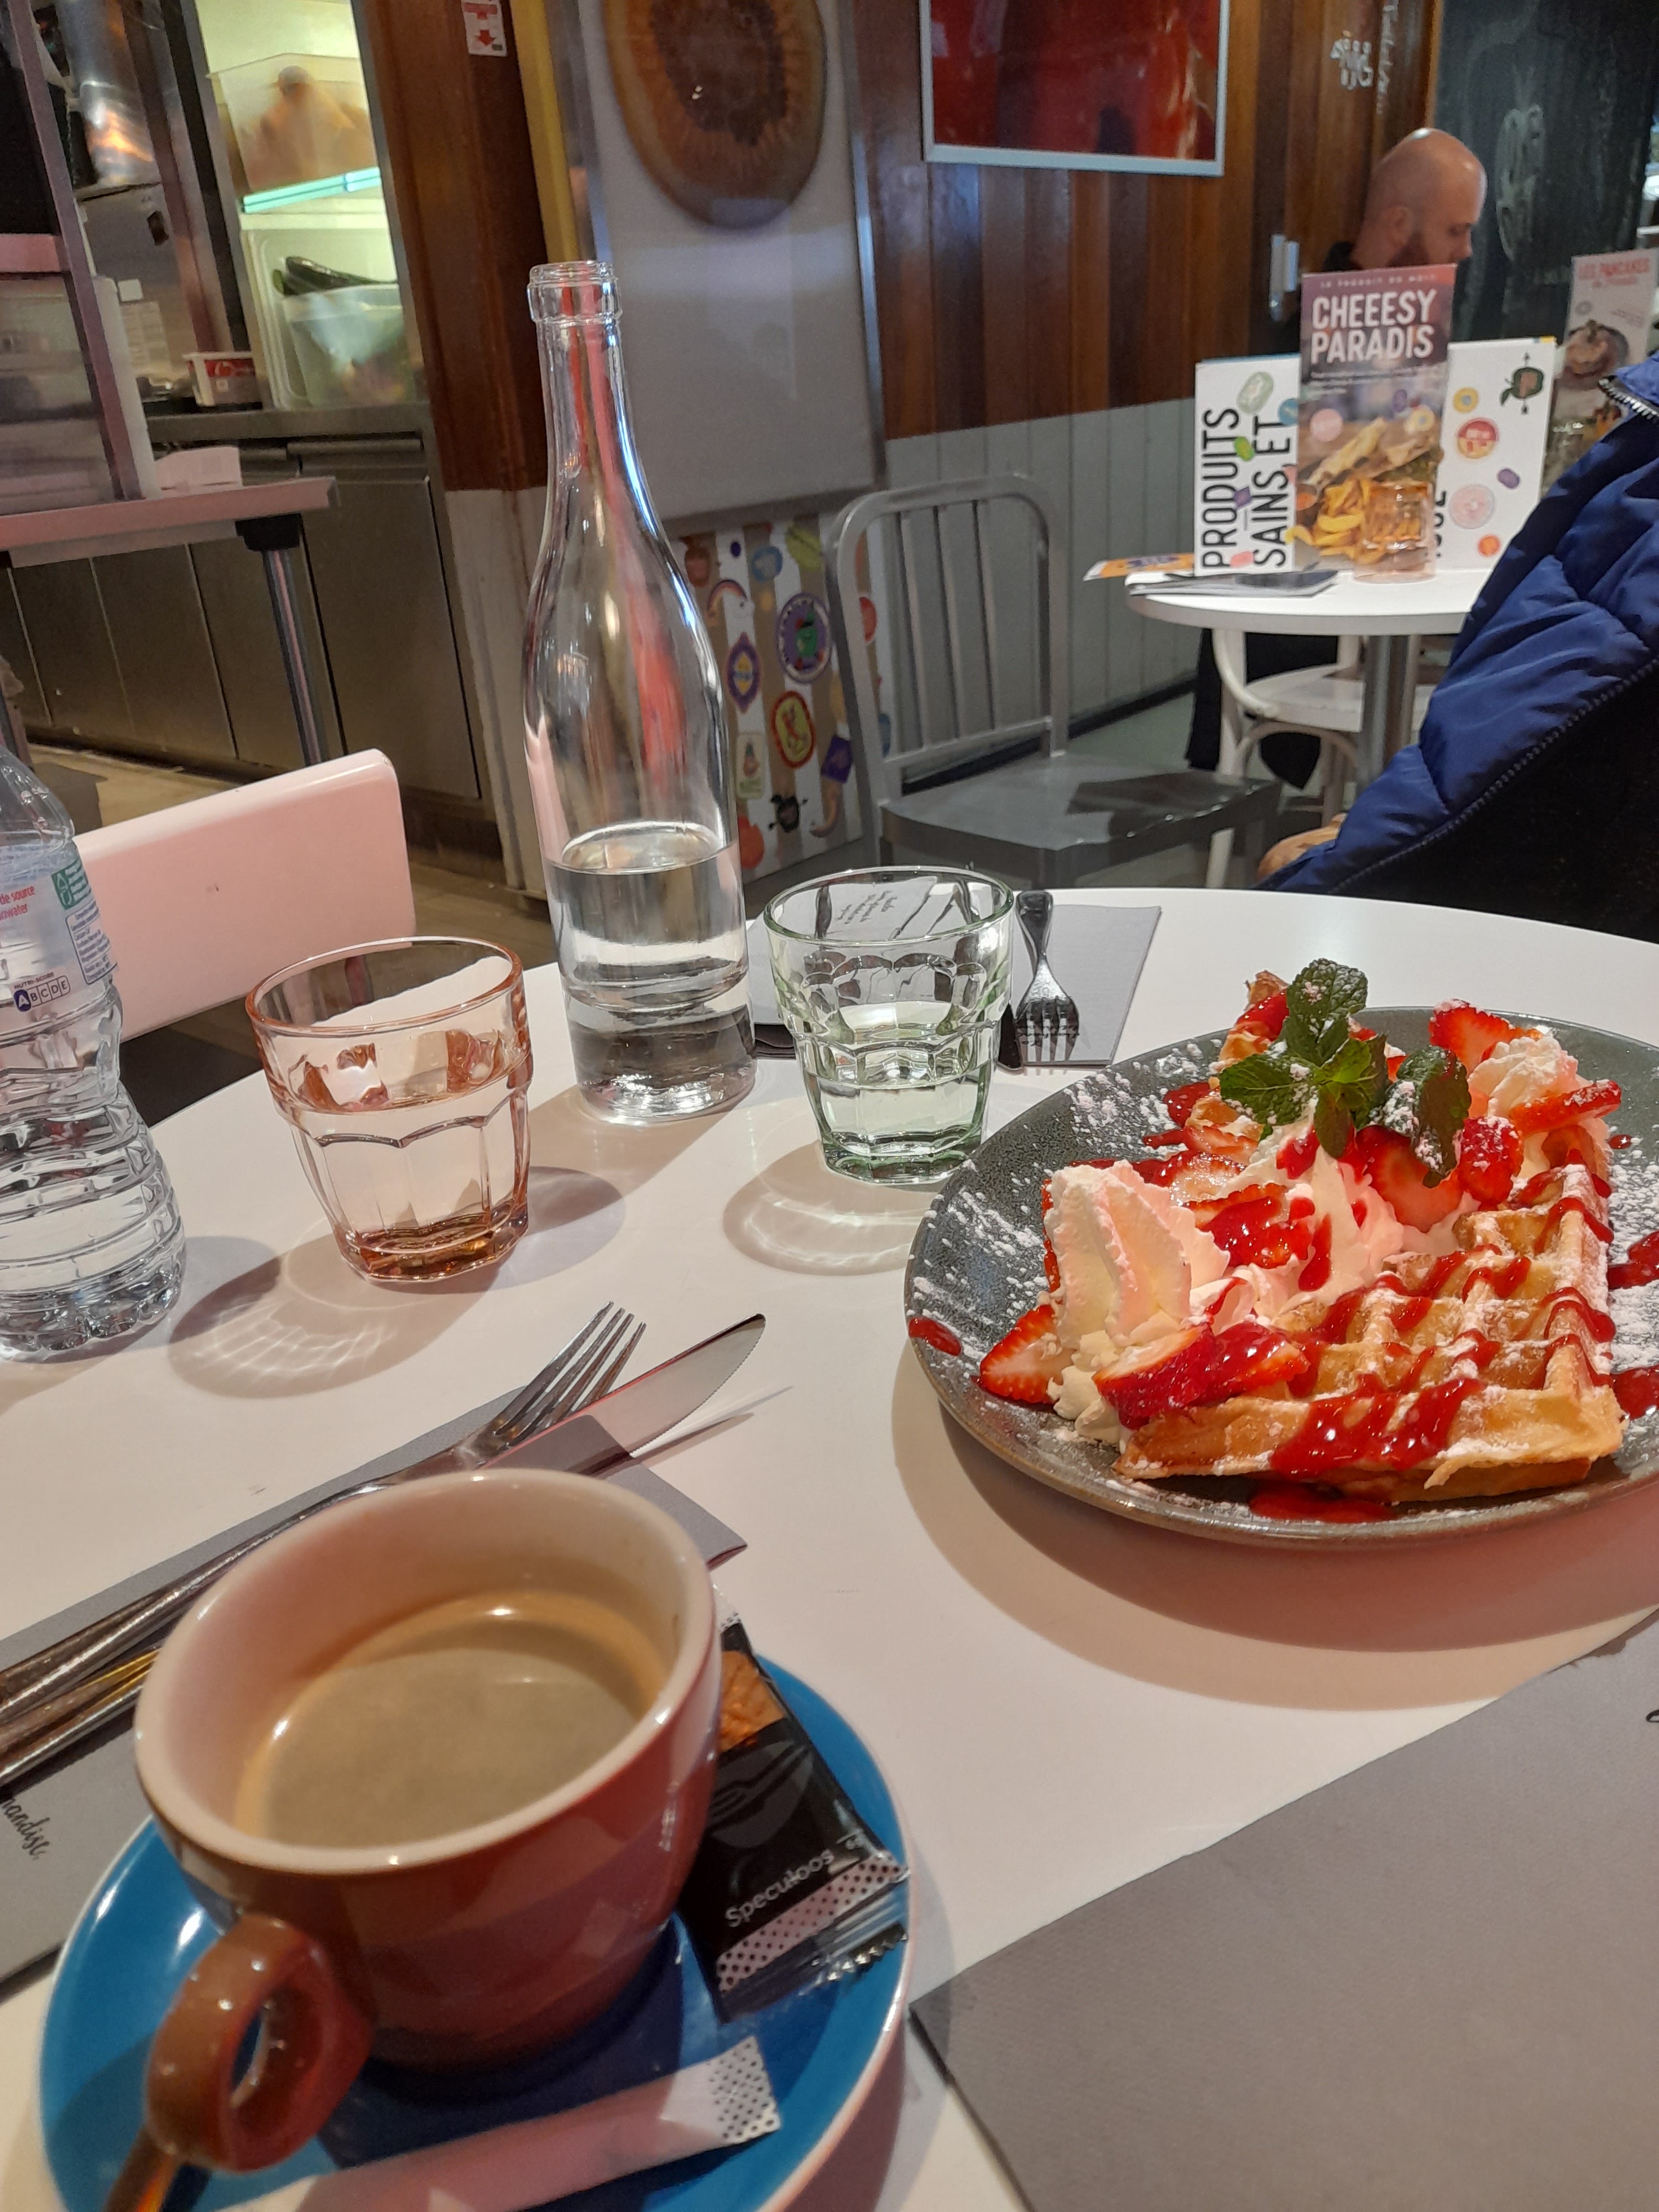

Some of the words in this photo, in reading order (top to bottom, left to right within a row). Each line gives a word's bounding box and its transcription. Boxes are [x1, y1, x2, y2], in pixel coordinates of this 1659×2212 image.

[1312, 288, 1437, 330] CHEEESY
[1310, 325, 1434, 364] PARADIS
[1253, 416, 1290, 454] ET
[1202, 408, 1239, 568] PRODUITS
[725, 1848, 835, 1928] Speculoos
